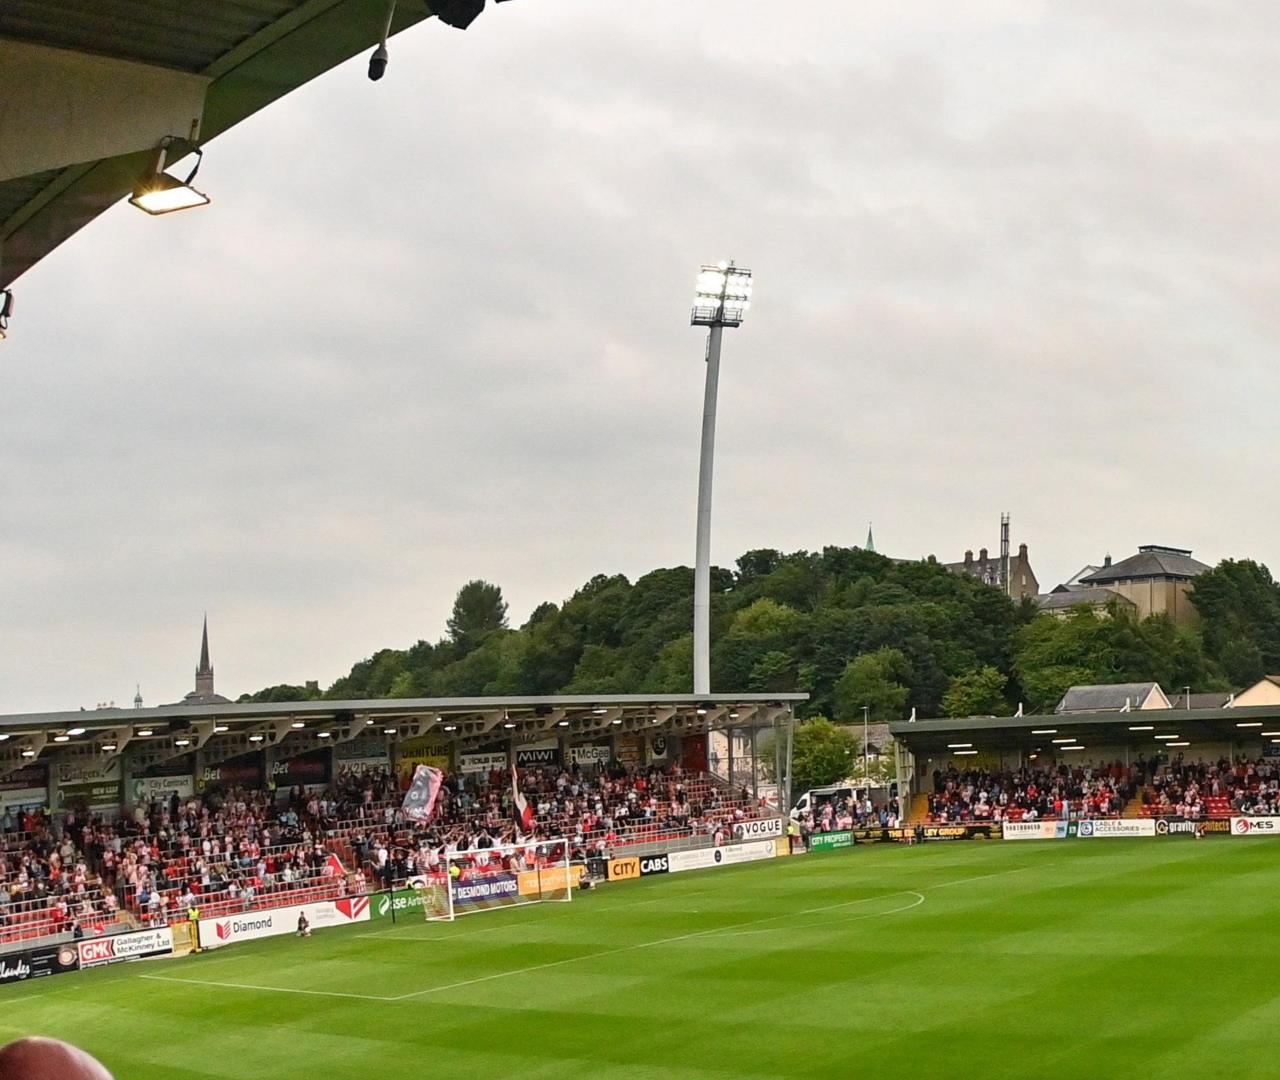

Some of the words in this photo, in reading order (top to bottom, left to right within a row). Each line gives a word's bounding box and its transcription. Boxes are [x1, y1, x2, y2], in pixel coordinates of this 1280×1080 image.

[518, 750, 554, 762] MIWI
[204, 767, 221, 781] Bet
[272, 761, 289, 775] Bet
[746, 820, 781, 835] VOGUE
[1169, 820, 1196, 833] gravity
[1250, 820, 1274, 829] MES
[888, 830, 903, 838] THE
[938, 828, 966, 837] GROUP
[811, 836, 823, 846] CITY
[613, 861, 637, 877] CITY
[640, 857, 668, 873] CABS
[457, 885, 490, 899] DESMOND
[490, 880, 518, 896] MOTORS
[232, 916, 273, 934] Diamond
[115, 935, 155, 948] Gallagher
[116, 941, 156, 954] McKinney
[157, 938, 171, 948] Ltd
[81, 941, 113, 961] GMK
